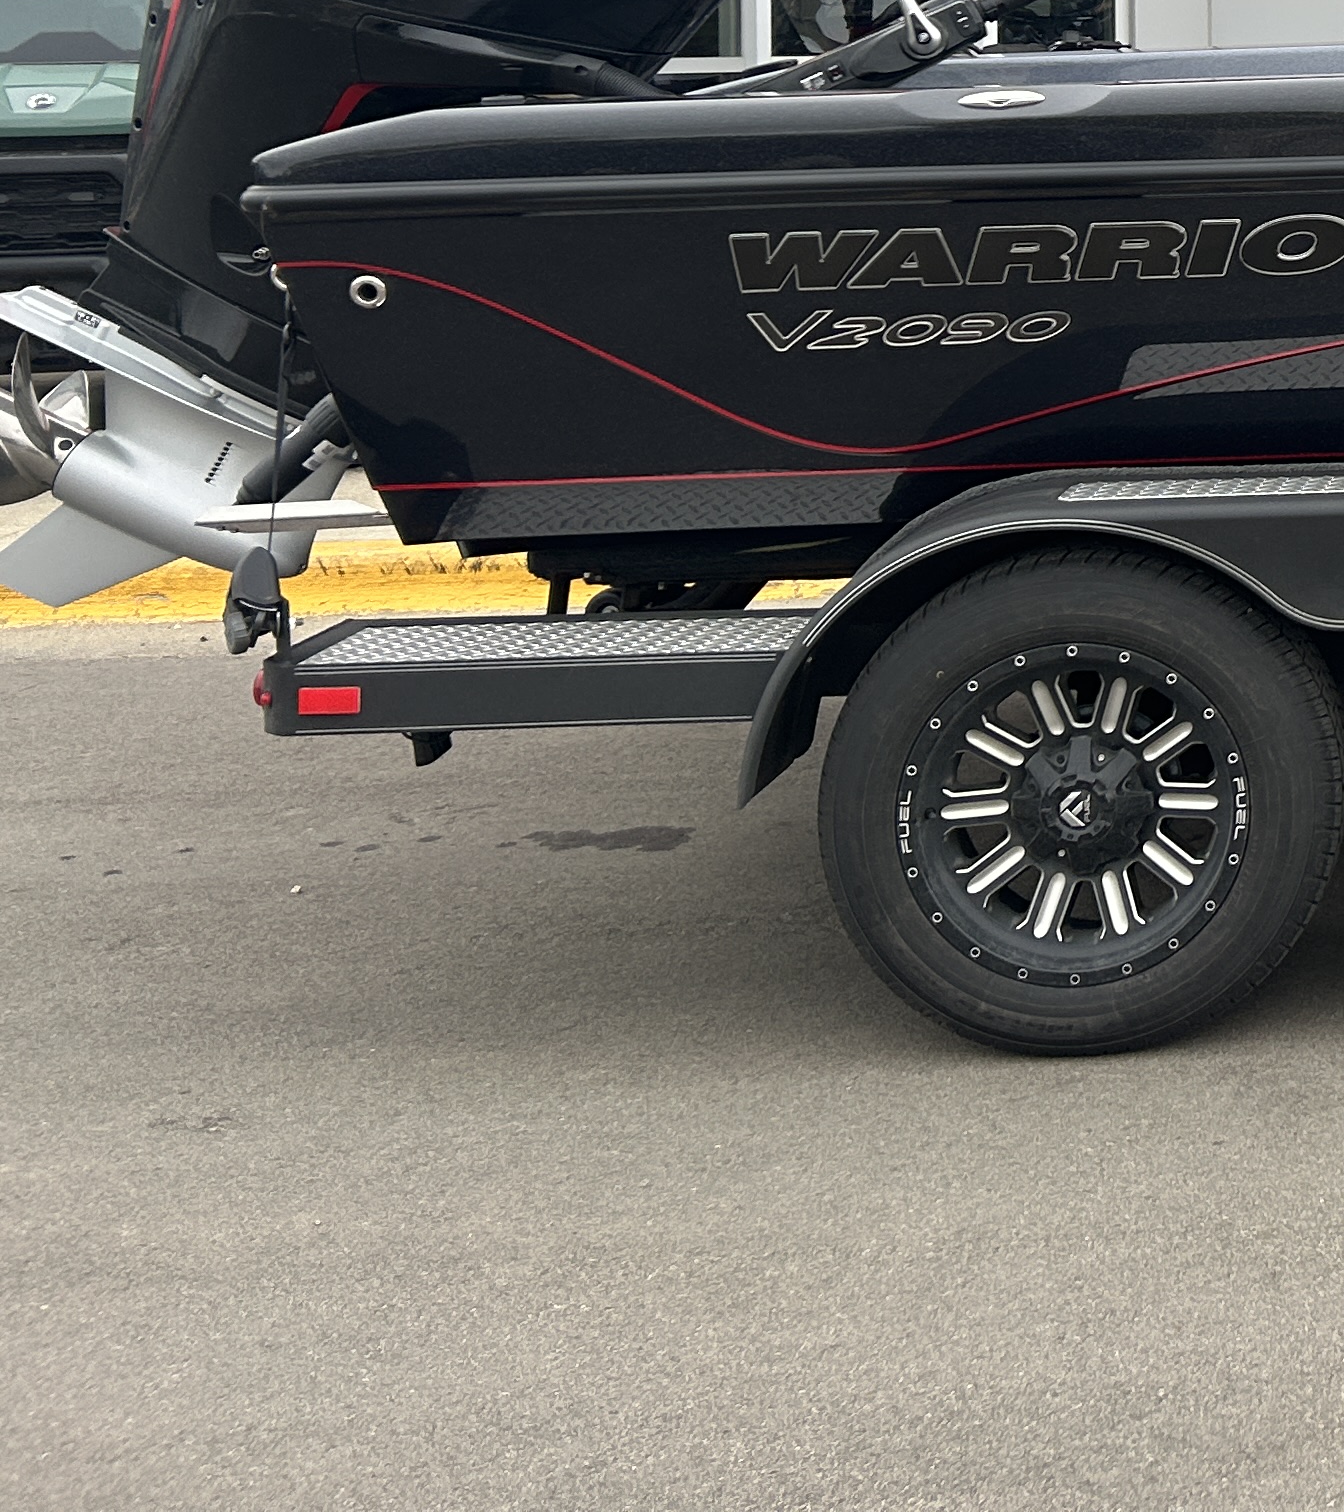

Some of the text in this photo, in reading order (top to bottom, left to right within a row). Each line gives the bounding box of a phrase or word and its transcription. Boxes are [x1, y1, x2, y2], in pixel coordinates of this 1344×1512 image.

[746, 309, 1072, 352] V2090
[899, 790, 913, 854] FUEL
[1232, 776, 1247, 841] FUEL
